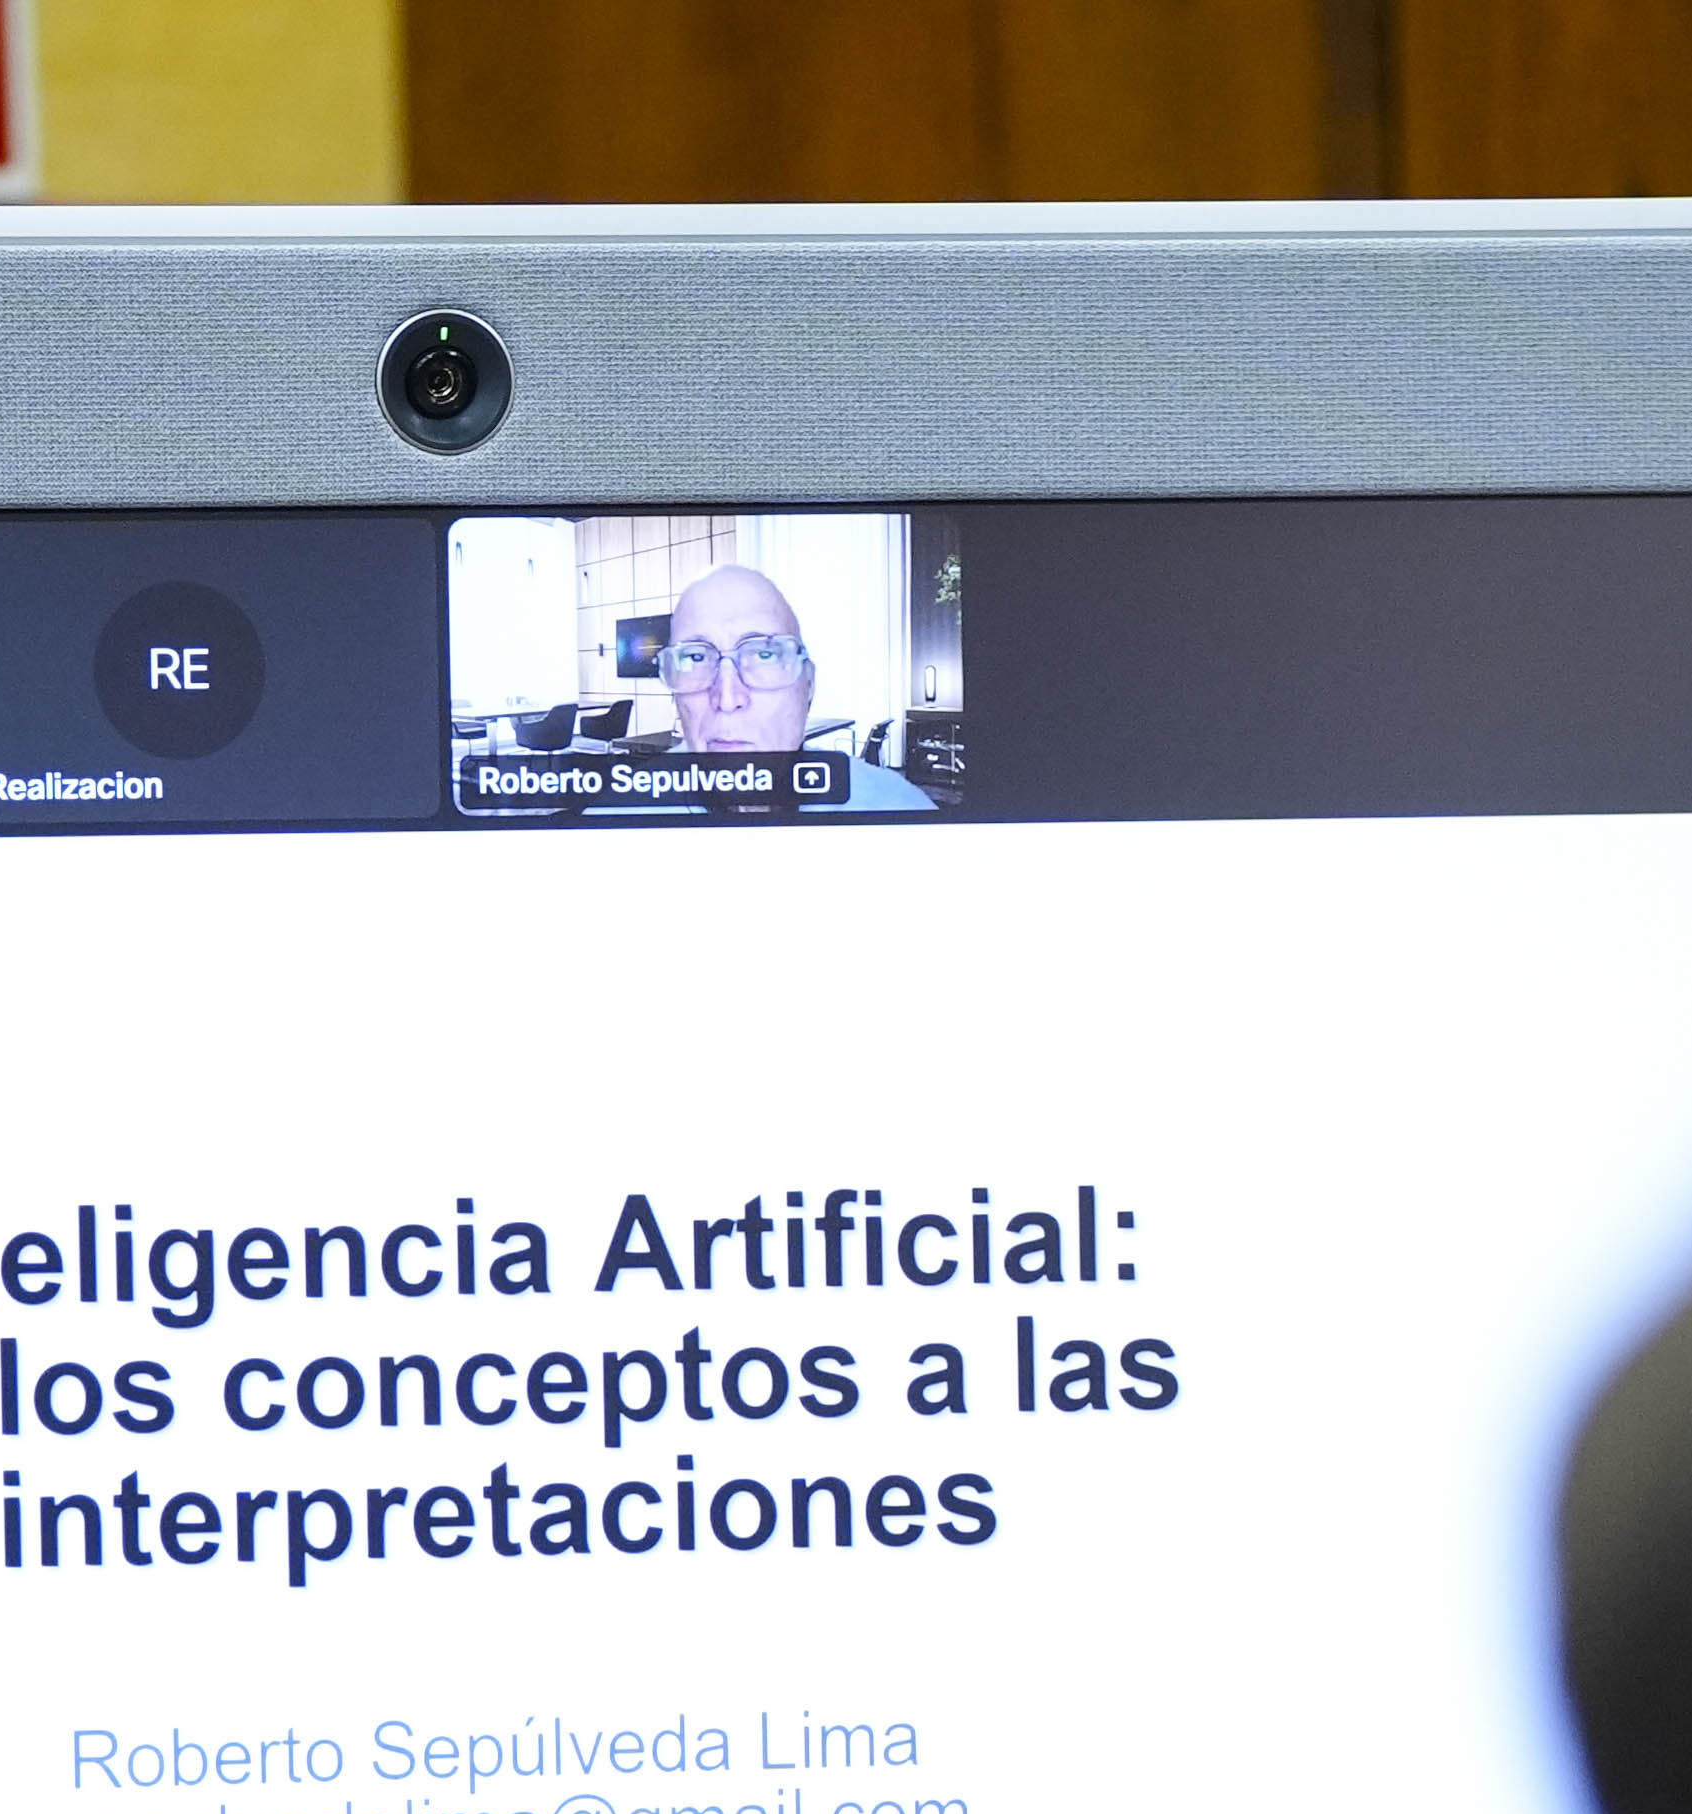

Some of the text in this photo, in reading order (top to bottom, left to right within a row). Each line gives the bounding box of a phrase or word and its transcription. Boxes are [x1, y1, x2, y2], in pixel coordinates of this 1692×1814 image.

[150, 647, 210, 690] RE
[478, 762, 773, 799] Roberto Sepulveda
[593, 1184, 1137, 1293] Artificial:
[222, 1325, 861, 1450] conceptos
[905, 1341, 969, 1417] a
[1015, 1314, 1180, 1414] las
[1, 1453, 998, 1589] interpretaciones
[72, 1708, 919, 1796] Roberto Sepúlveda Lima
